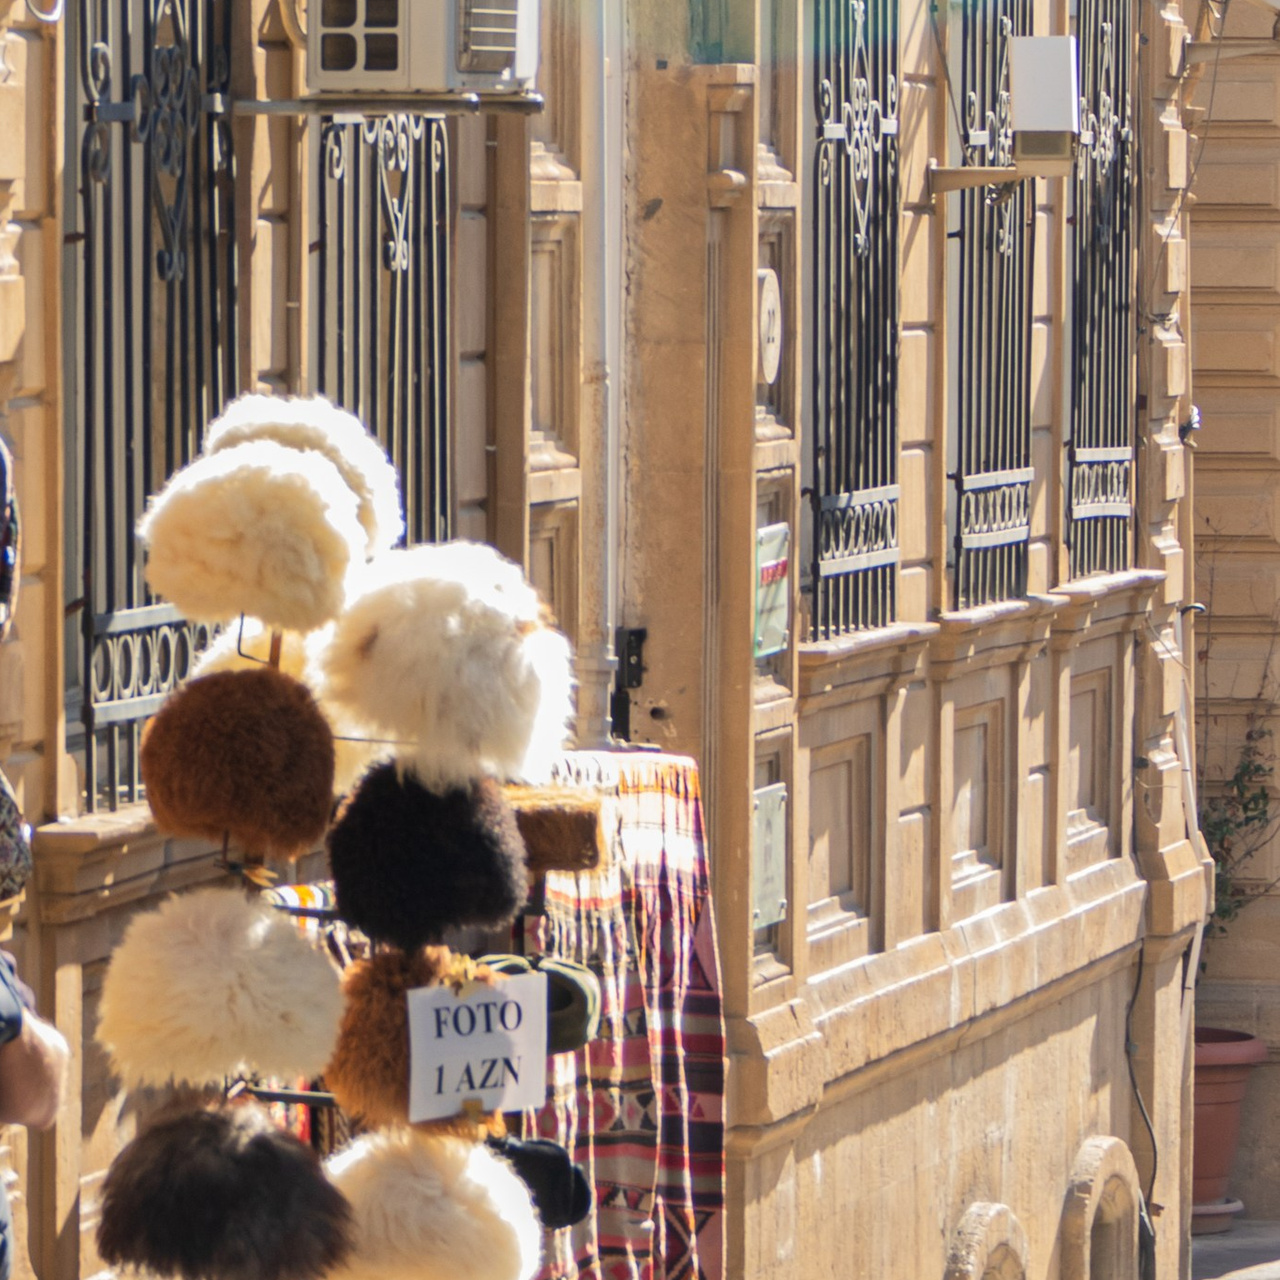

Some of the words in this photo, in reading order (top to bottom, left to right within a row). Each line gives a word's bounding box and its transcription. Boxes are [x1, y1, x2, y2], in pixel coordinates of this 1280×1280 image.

[434, 1001, 522, 1038] FOTO
[435, 1065, 444, 1094] 1
[456, 1057, 521, 1092] AZN
